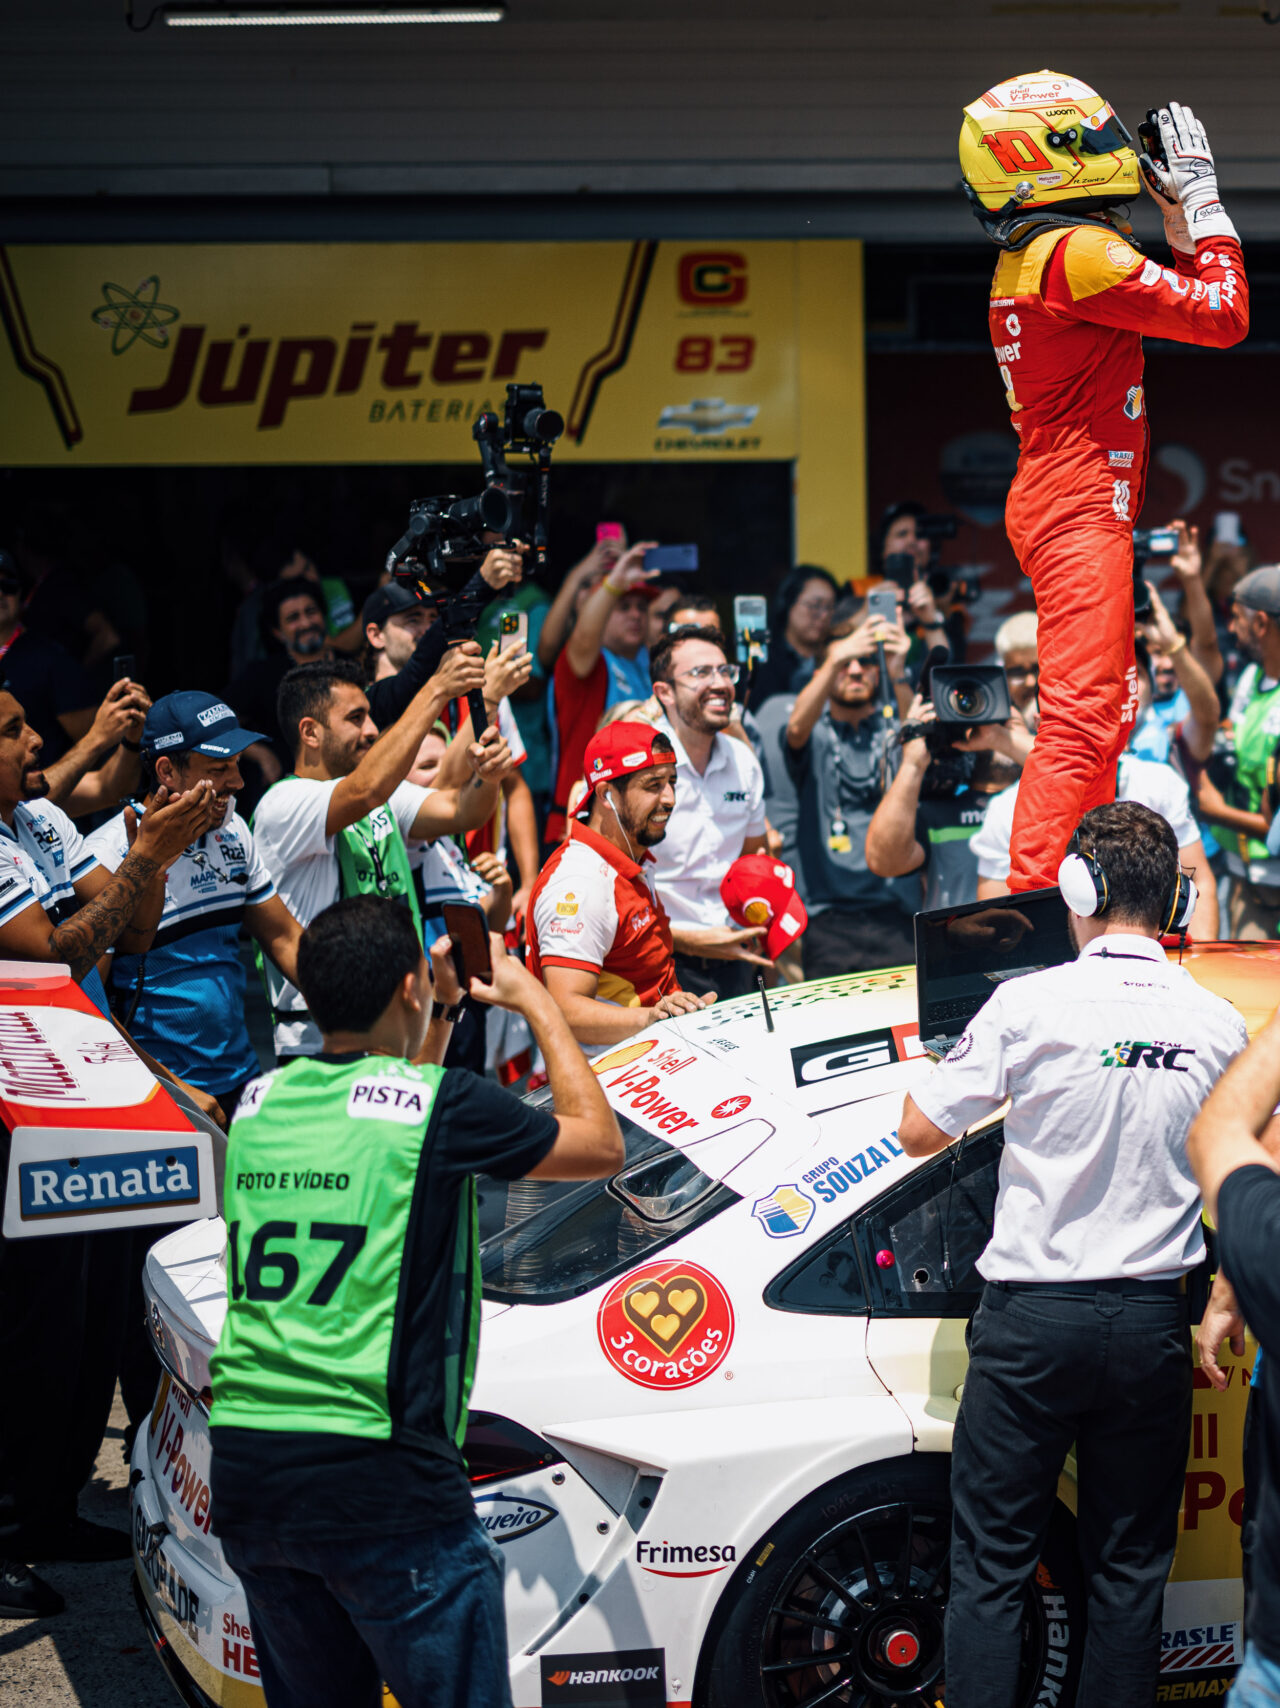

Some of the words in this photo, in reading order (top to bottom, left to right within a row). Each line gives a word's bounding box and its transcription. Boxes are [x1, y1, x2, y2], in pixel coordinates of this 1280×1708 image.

[1010, 92, 1060, 102] V-Power
[981, 130, 1054, 174] 10
[675, 333, 757, 374] 83
[128, 321, 549, 430] Júpiter
[368, 399, 505, 423] BATERIA
[647, 1047, 698, 1076] Shell
[352, 1084, 424, 1112] PISTA
[605, 1065, 700, 1135] V-Power
[30, 1159, 193, 1207] Renata
[236, 1171, 275, 1191] FOTO
[279, 1171, 290, 1190] E
[297, 1168, 350, 1191] VÍDEO
[801, 1156, 840, 1184] GRUPO
[812, 1146, 882, 1203] SOUZA
[611, 1331, 634, 1351] 3
[622, 1326, 724, 1381] corações
[636, 1540, 738, 1566] Frimesa
